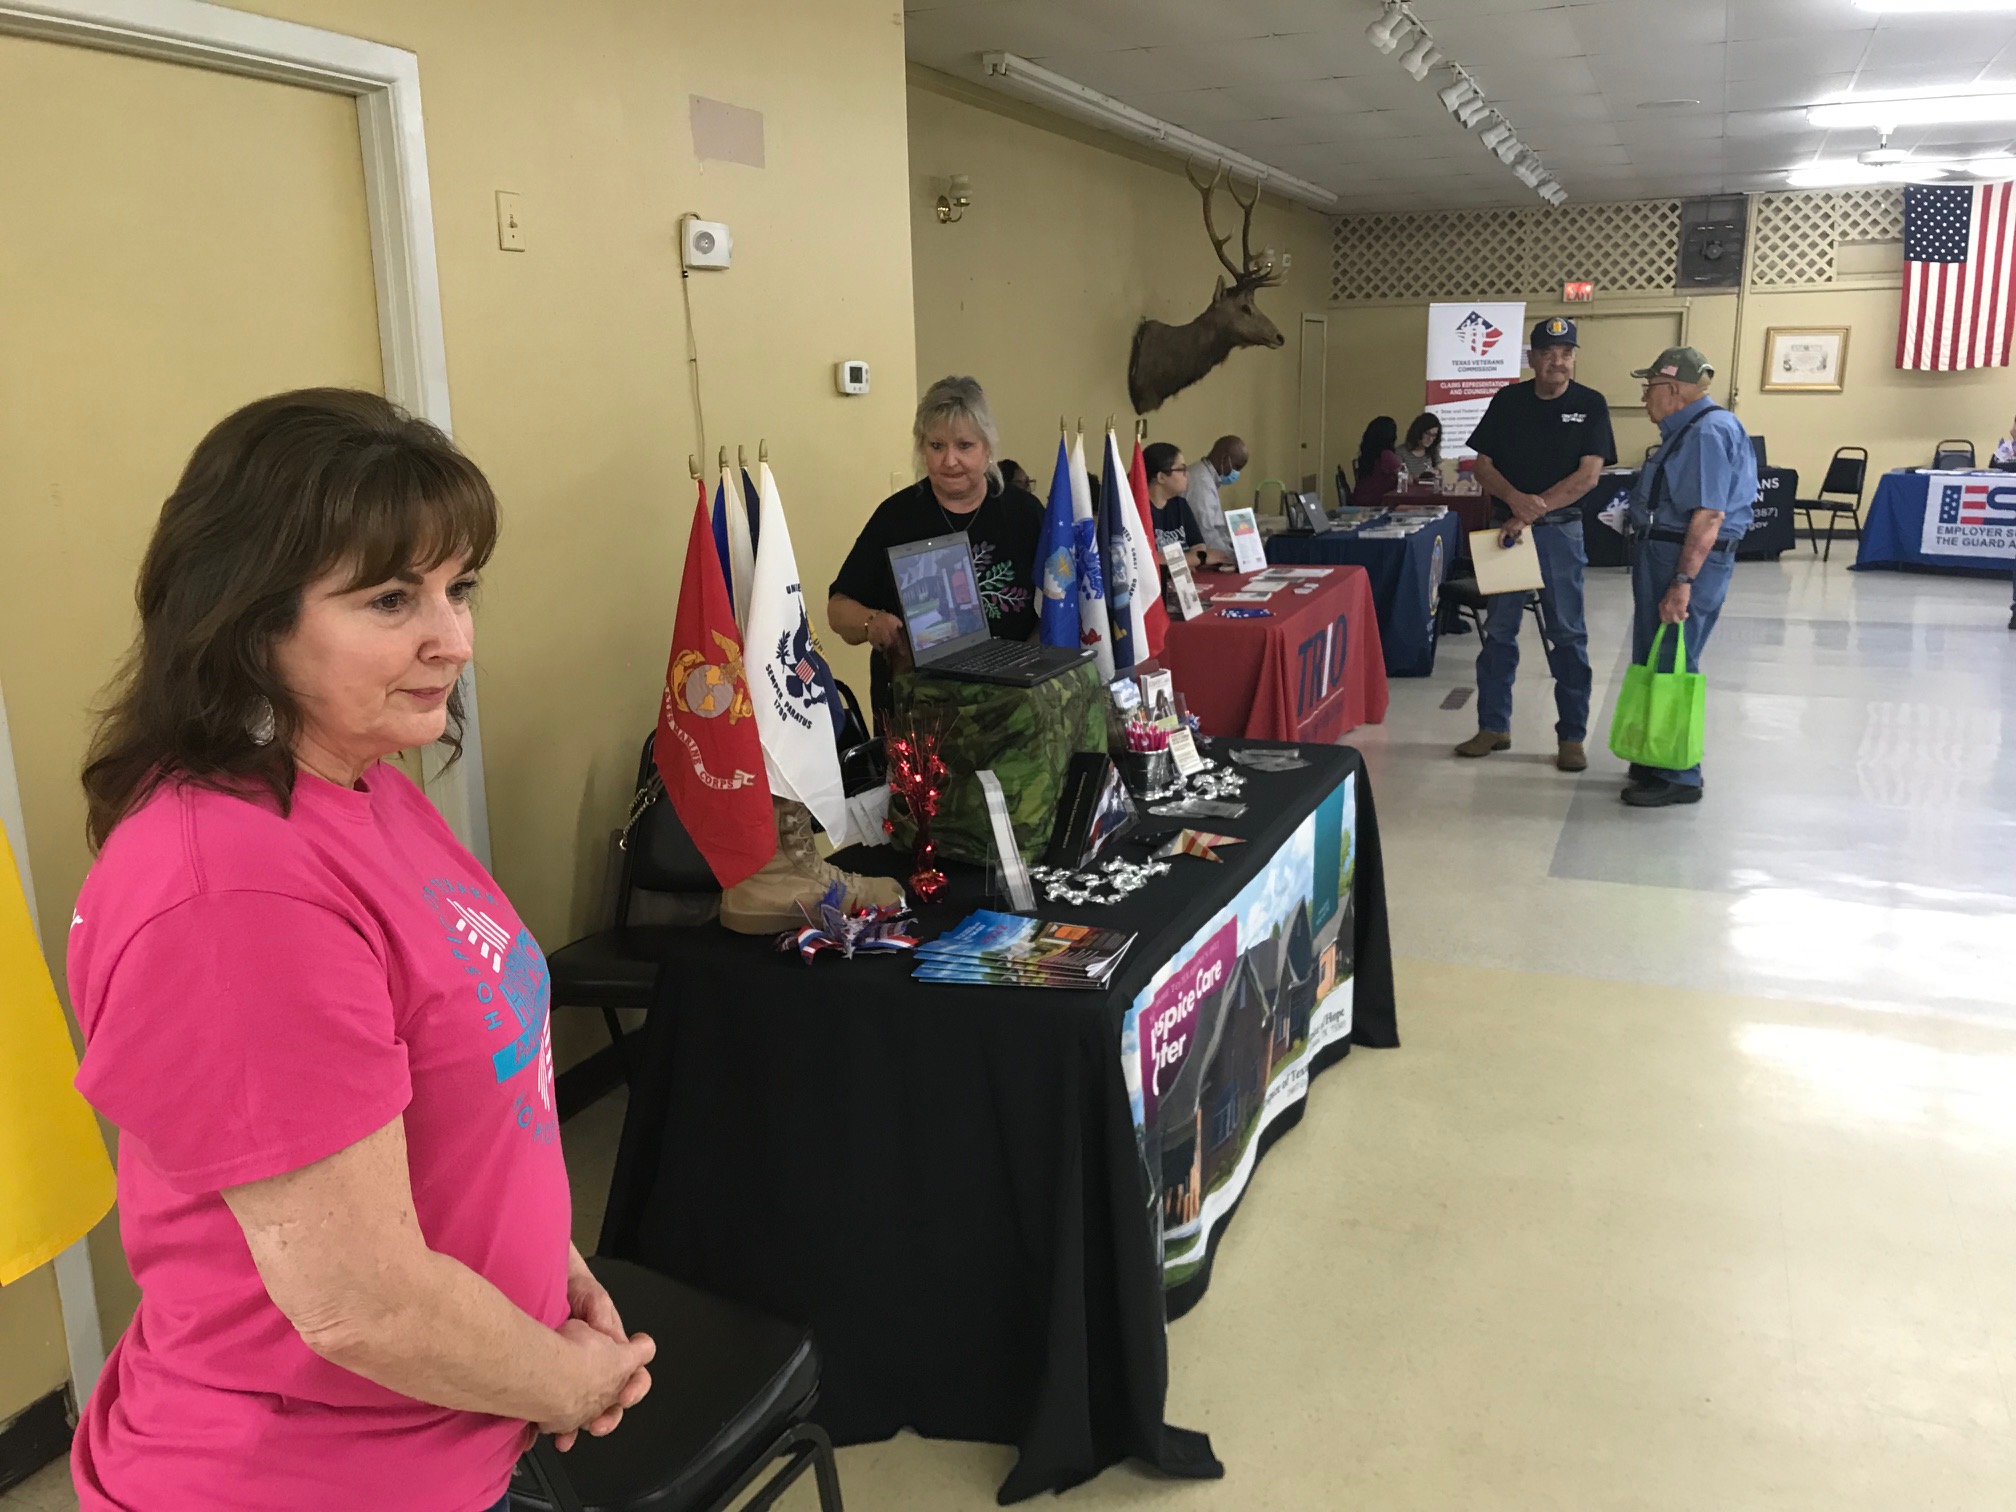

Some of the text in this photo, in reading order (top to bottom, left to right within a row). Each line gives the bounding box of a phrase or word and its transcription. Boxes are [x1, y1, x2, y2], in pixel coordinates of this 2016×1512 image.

[1936, 526, 2003, 537] EMPLOYER
[1936, 536, 1959, 546] THE
[1962, 537, 2006, 549] GUARD
[1297, 612, 1348, 718] TRIO
[765, 663, 813, 730] SEMPER PARATUS
[672, 723, 734, 789] MARINE CORPS
[1195, 959, 1222, 999] Care
